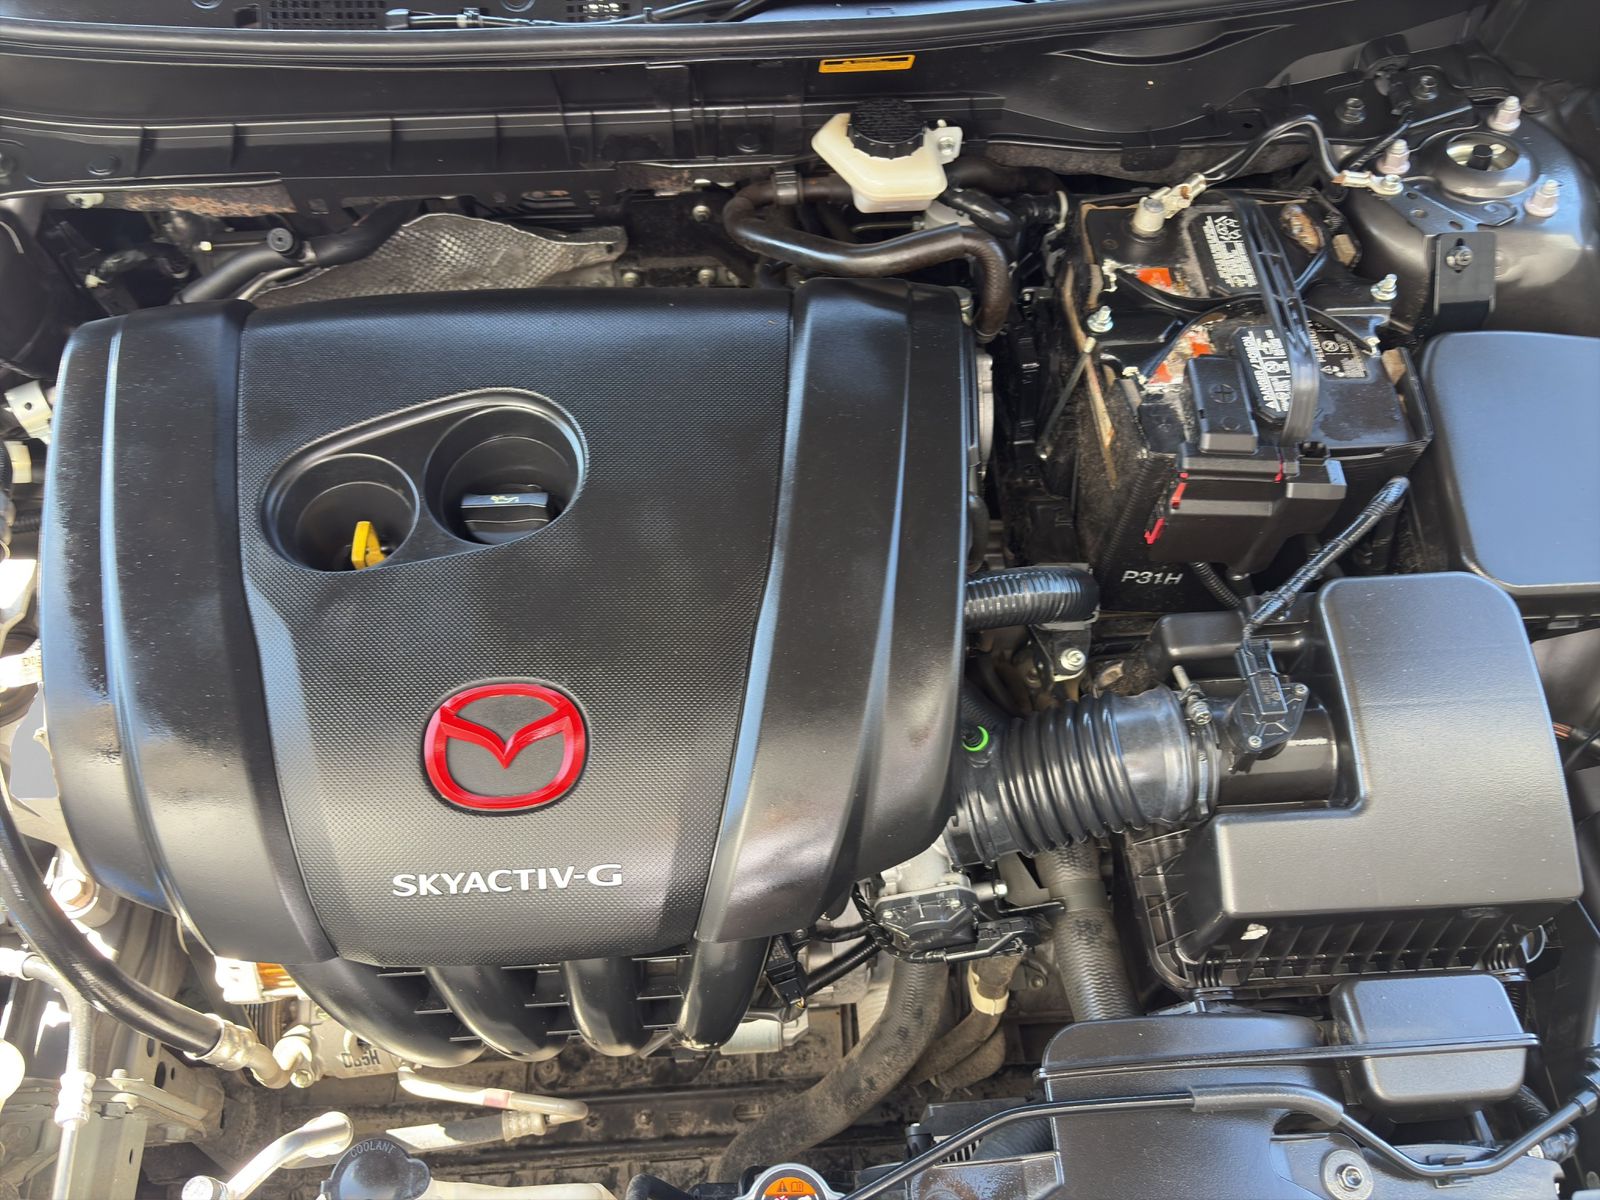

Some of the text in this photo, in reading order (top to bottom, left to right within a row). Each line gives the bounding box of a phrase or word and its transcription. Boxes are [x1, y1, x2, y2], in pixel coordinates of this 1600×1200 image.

[1120, 569, 1184, 585] P31H
[392, 863, 623, 897] SKYACTIV-G
[350, 1140, 398, 1158] COOLANT
